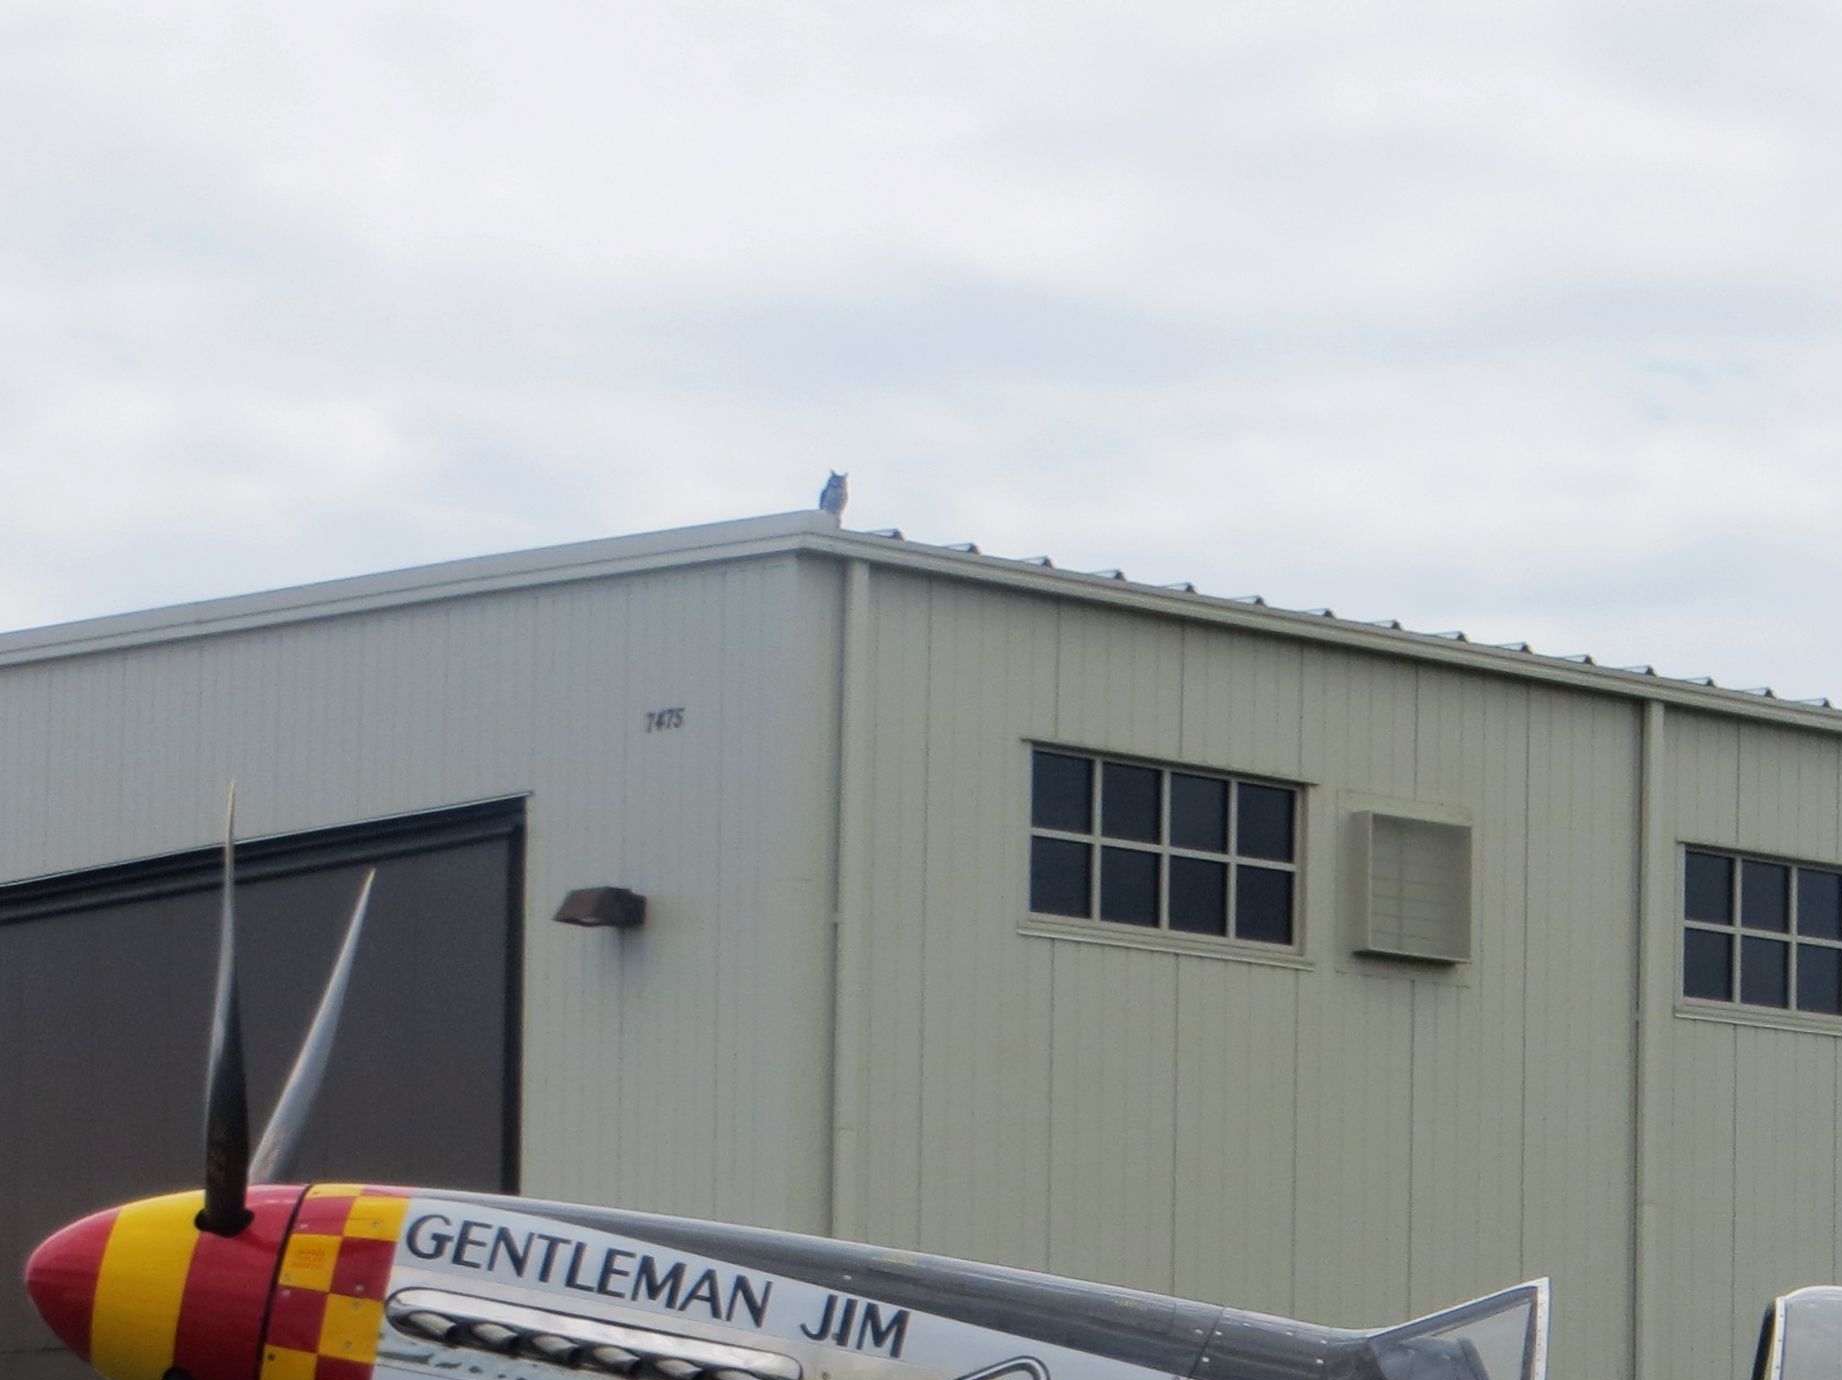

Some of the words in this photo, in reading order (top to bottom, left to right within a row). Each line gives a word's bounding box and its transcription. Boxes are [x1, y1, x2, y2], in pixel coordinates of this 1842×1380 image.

[646, 707, 685, 734] 7475
[406, 1214, 773, 1328] GENTLEMAN
[801, 1294, 911, 1359] JIM
